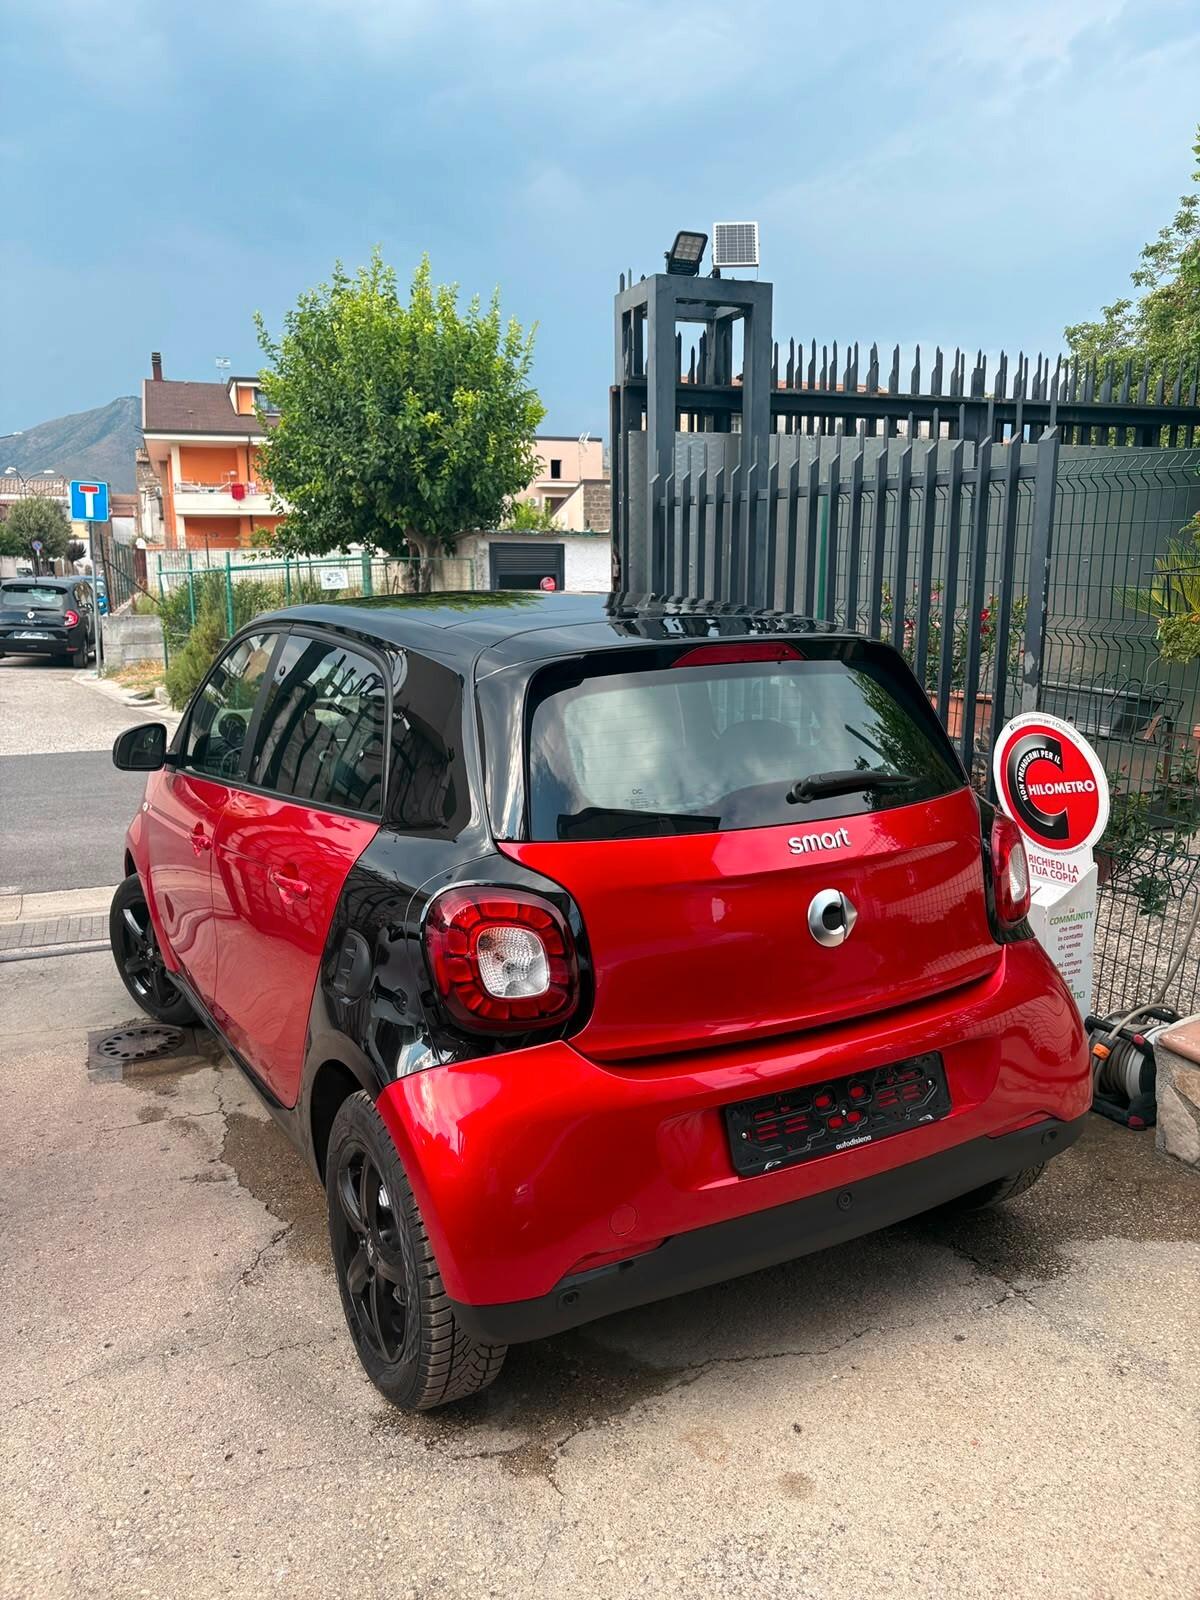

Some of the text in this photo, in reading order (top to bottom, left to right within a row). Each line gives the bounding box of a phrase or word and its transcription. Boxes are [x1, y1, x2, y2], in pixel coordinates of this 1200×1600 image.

[1018, 750, 1060, 800] NON PRENDERMI PER IL
[788, 828, 852, 855] smart
[1028, 854, 1080, 875] RICHIEDI LA
[1030, 864, 1078, 883] TUA COPIA
[1050, 910, 1094, 926] COMMUNITY
